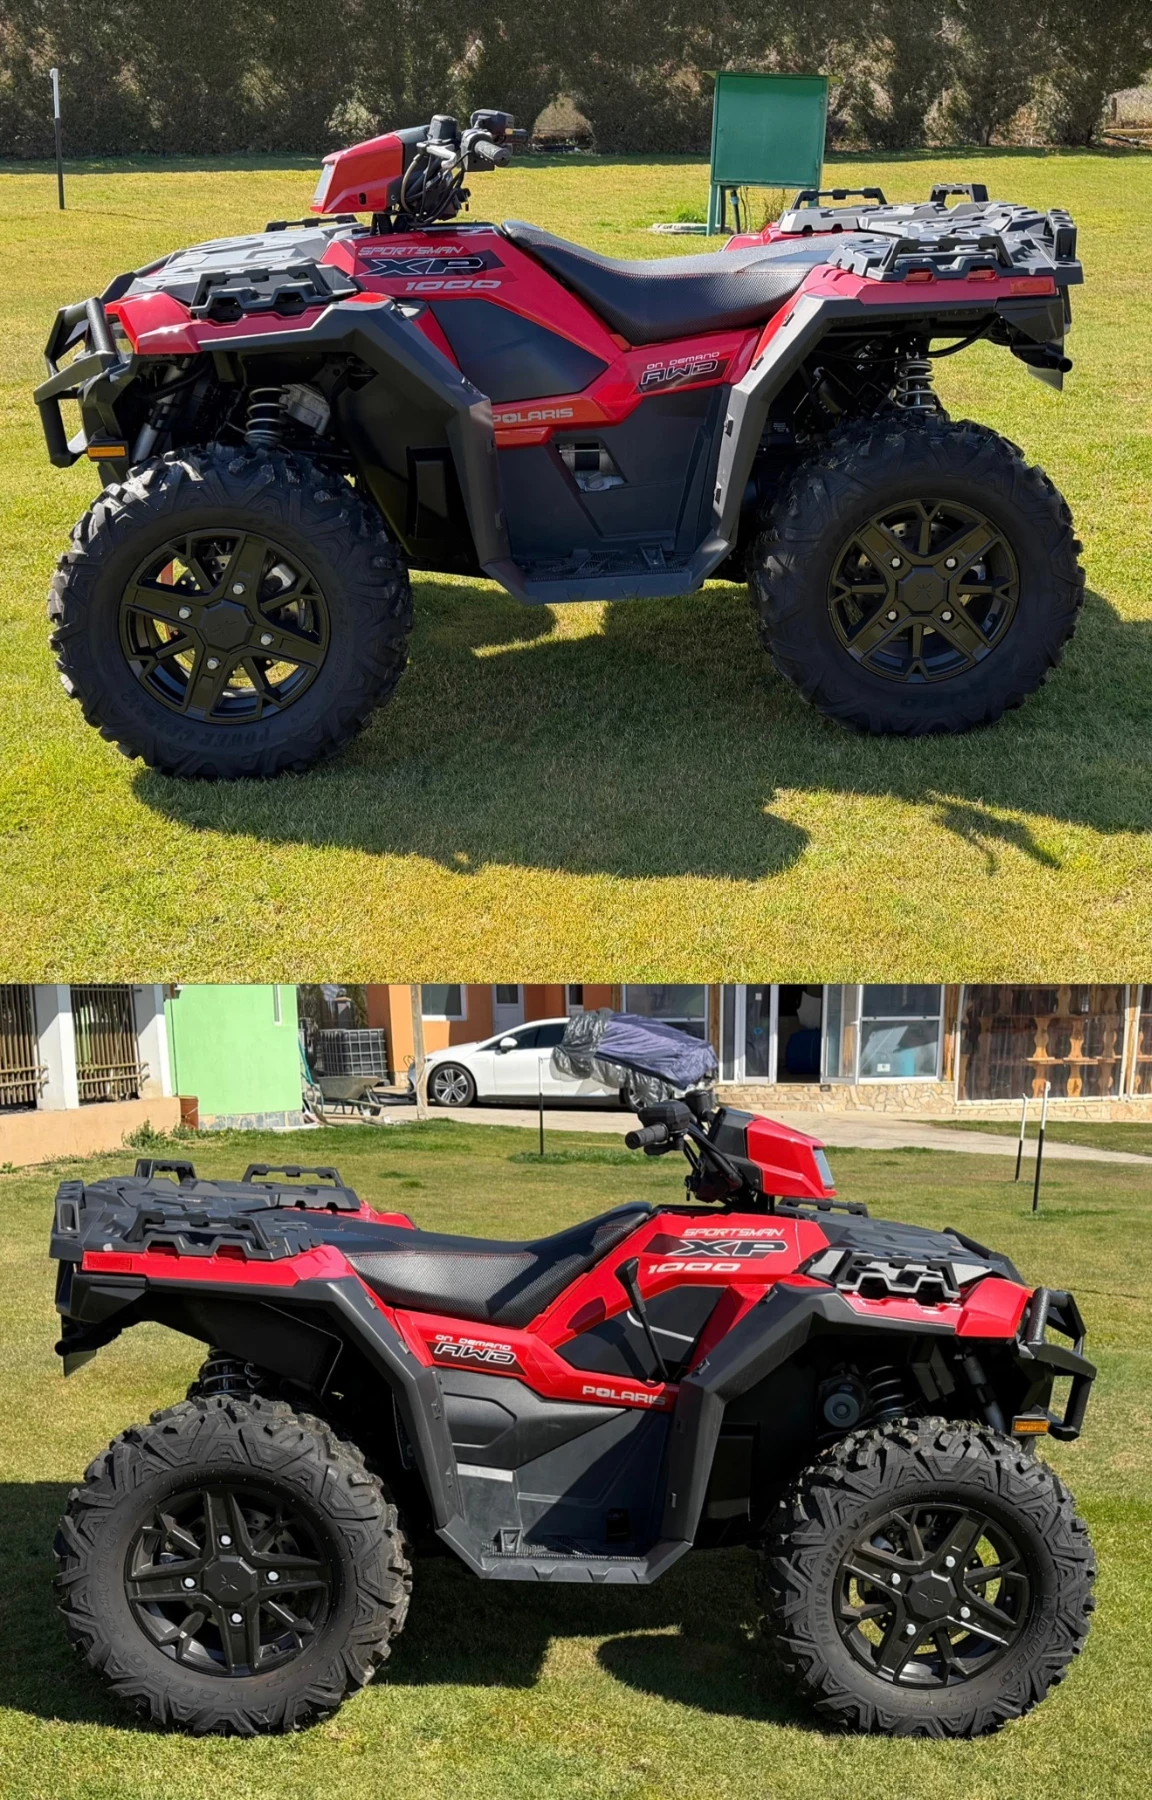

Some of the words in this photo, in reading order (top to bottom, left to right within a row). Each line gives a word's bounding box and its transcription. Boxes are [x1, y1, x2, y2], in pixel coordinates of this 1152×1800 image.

[358, 246, 463, 256] SPORTSMAN
[357, 257, 483, 276] XP
[405, 279, 501, 290] 1000
[647, 361, 663, 370] ON
[669, 351, 720, 366] DEMAND
[641, 358, 718, 385] AWD
[493, 407, 574, 424] POLARIS
[682, 1227, 785, 1237] SPORTSMAN
[664, 1239, 789, 1256] XP
[648, 1262, 741, 1274] 1000
[435, 1334, 453, 1342] ON
[458, 1337, 512, 1351] DEMAND
[434, 1341, 517, 1365] AWD
[582, 1385, 666, 1406] POLARIS
